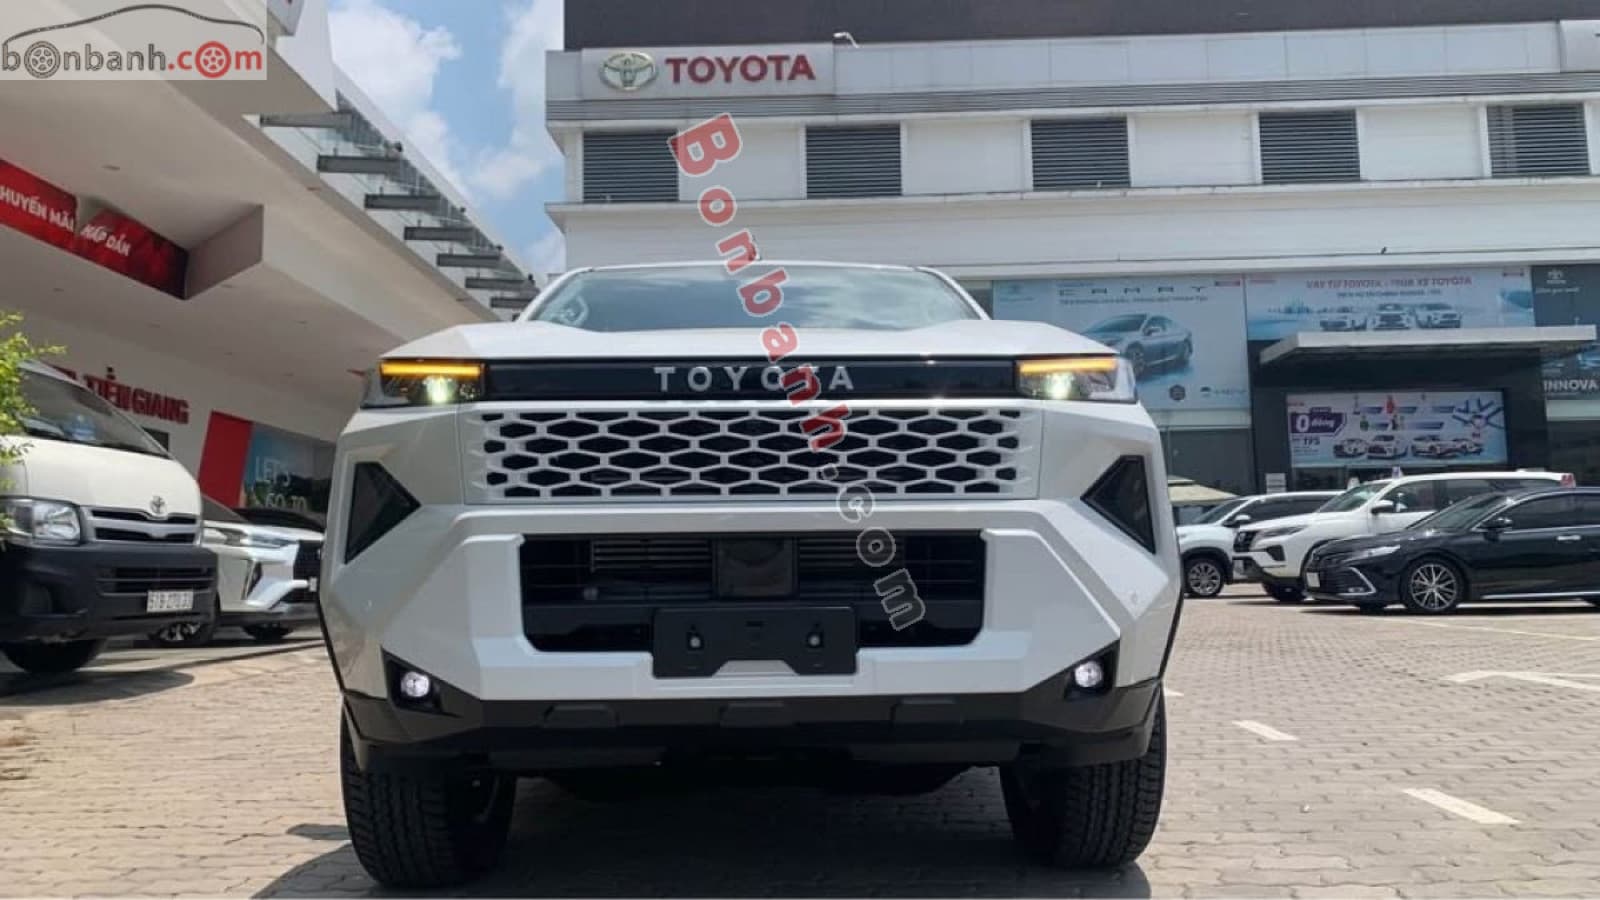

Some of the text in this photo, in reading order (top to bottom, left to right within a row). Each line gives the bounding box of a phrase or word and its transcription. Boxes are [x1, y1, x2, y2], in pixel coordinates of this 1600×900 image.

[665, 54, 817, 84] TOYOTA
[1543, 379, 1599, 392] INNOVA
[132, 387, 190, 425] GIANG
